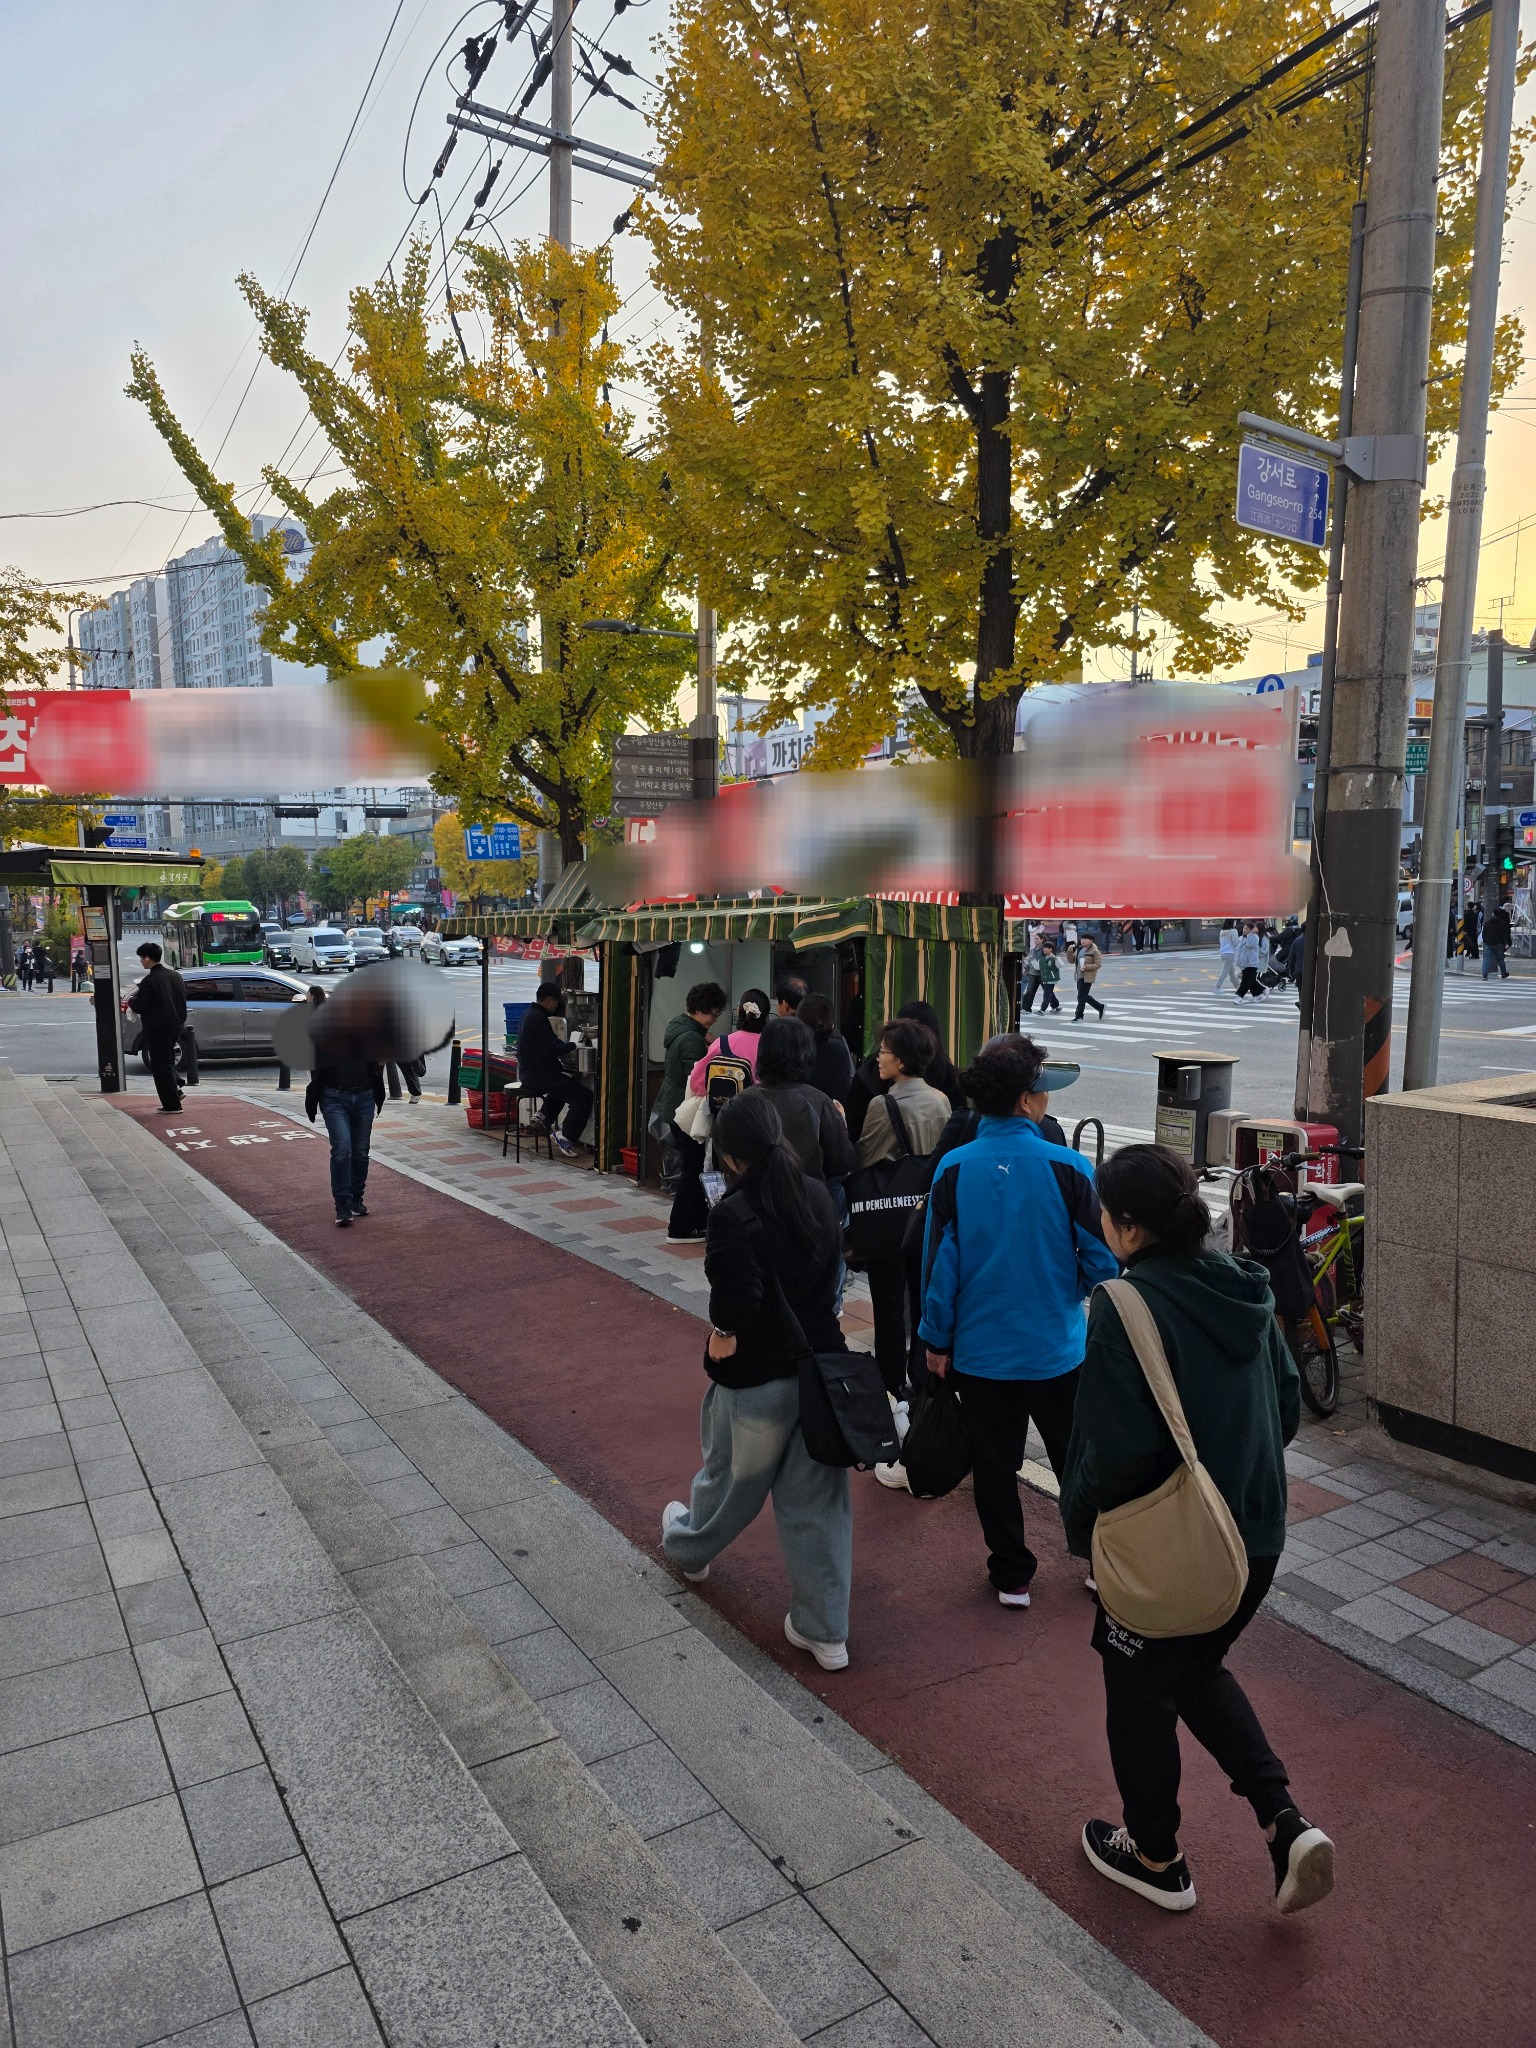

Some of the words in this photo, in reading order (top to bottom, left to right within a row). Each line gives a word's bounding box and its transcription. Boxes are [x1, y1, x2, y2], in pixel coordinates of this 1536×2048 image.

[1257, 456, 1297, 489] 강서로
[1314, 474, 1320, 488] 2
[1247, 483, 1304, 514] Gangseo-ro
[1308, 506, 1323, 521] 254
[851, 1201, 865, 1214] ANN
